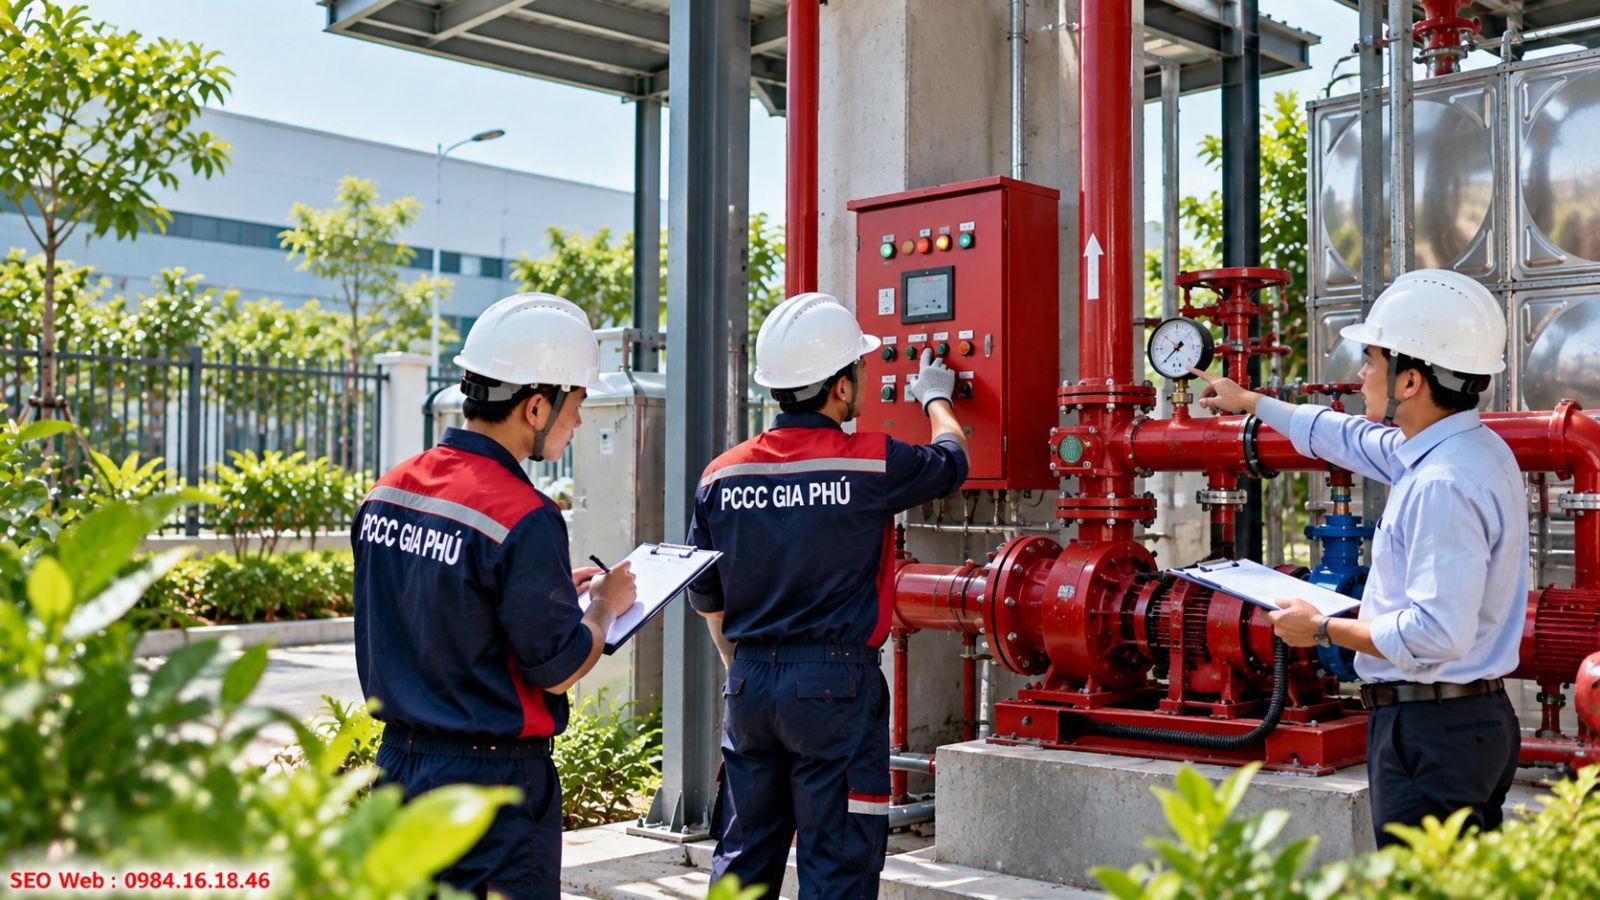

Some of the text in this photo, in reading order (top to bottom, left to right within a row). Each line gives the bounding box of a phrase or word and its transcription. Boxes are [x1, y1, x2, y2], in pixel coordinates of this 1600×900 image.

[721, 475, 851, 511] PCCC GIA PHÚ
[360, 513, 463, 565] PCCC GIA PHÚ
